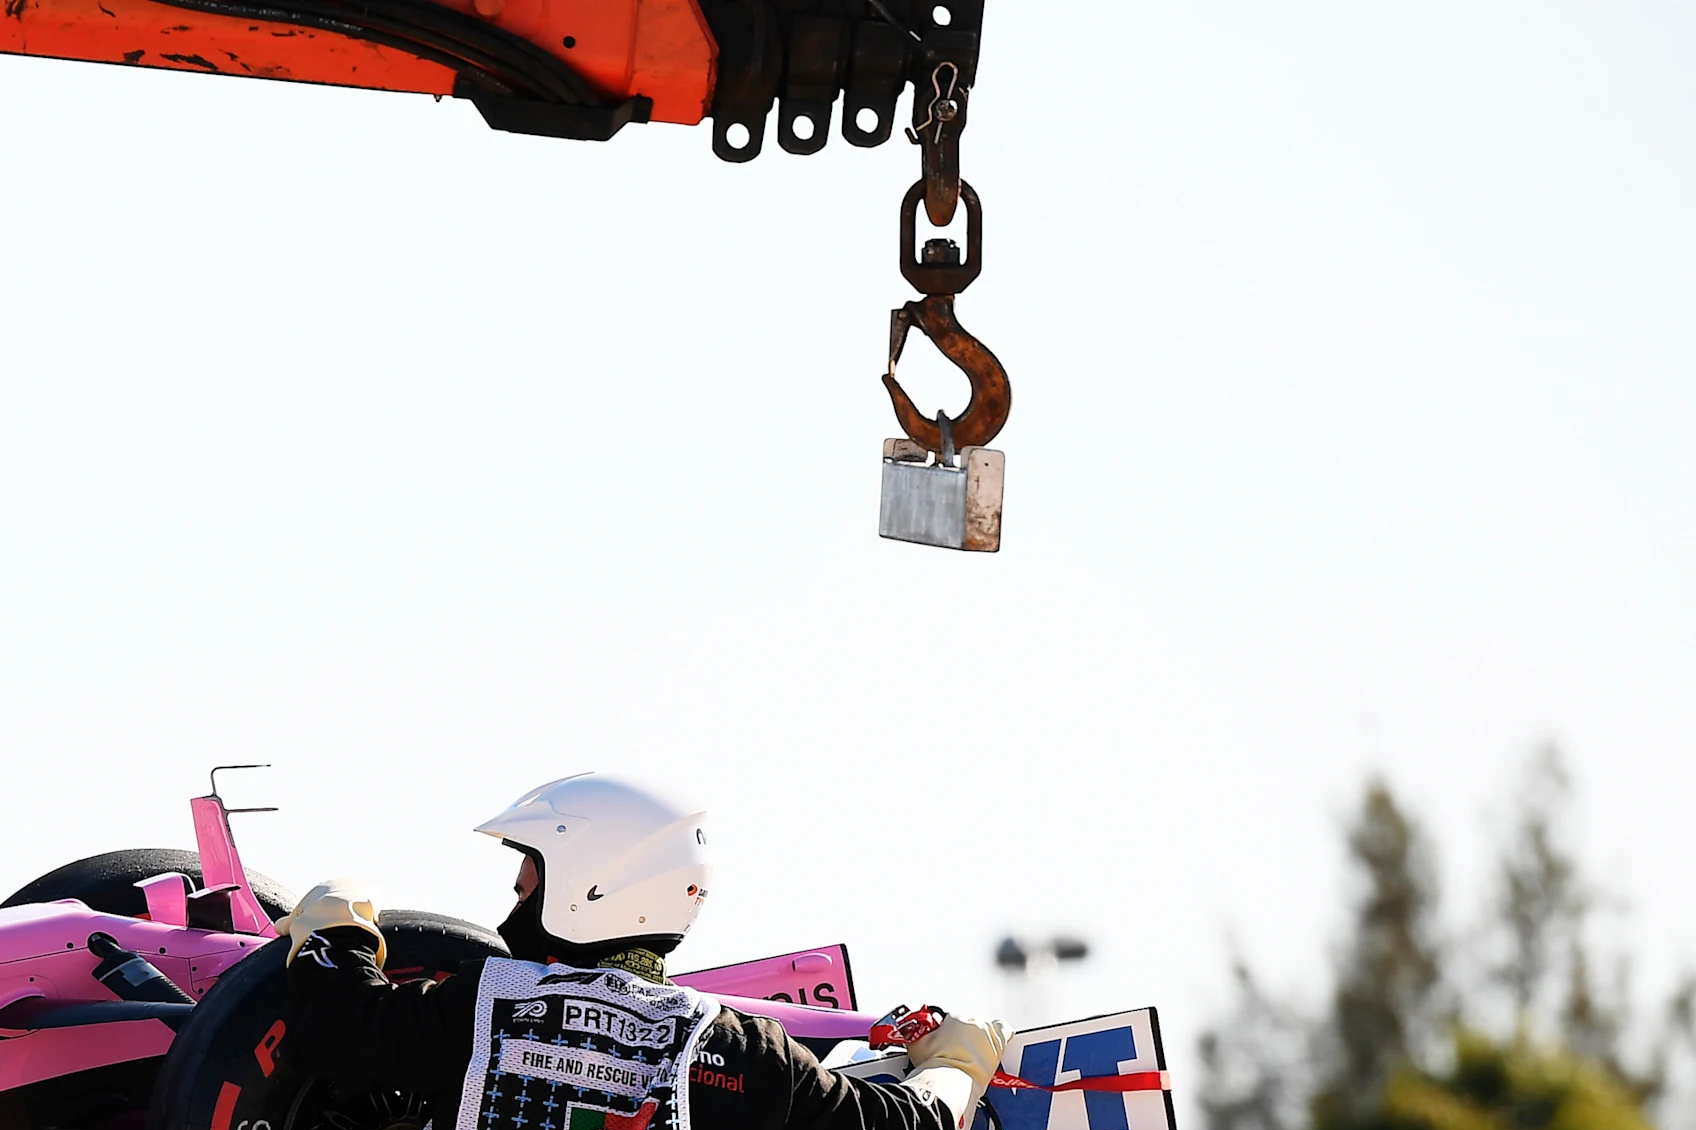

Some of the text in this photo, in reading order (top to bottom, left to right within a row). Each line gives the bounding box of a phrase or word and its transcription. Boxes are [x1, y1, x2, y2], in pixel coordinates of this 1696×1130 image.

[522, 1051, 552, 1070] FIRE
[556, 1059, 583, 1075] AND
[586, 1064, 637, 1086] RESCUE
[689, 1063, 745, 1093] cional
